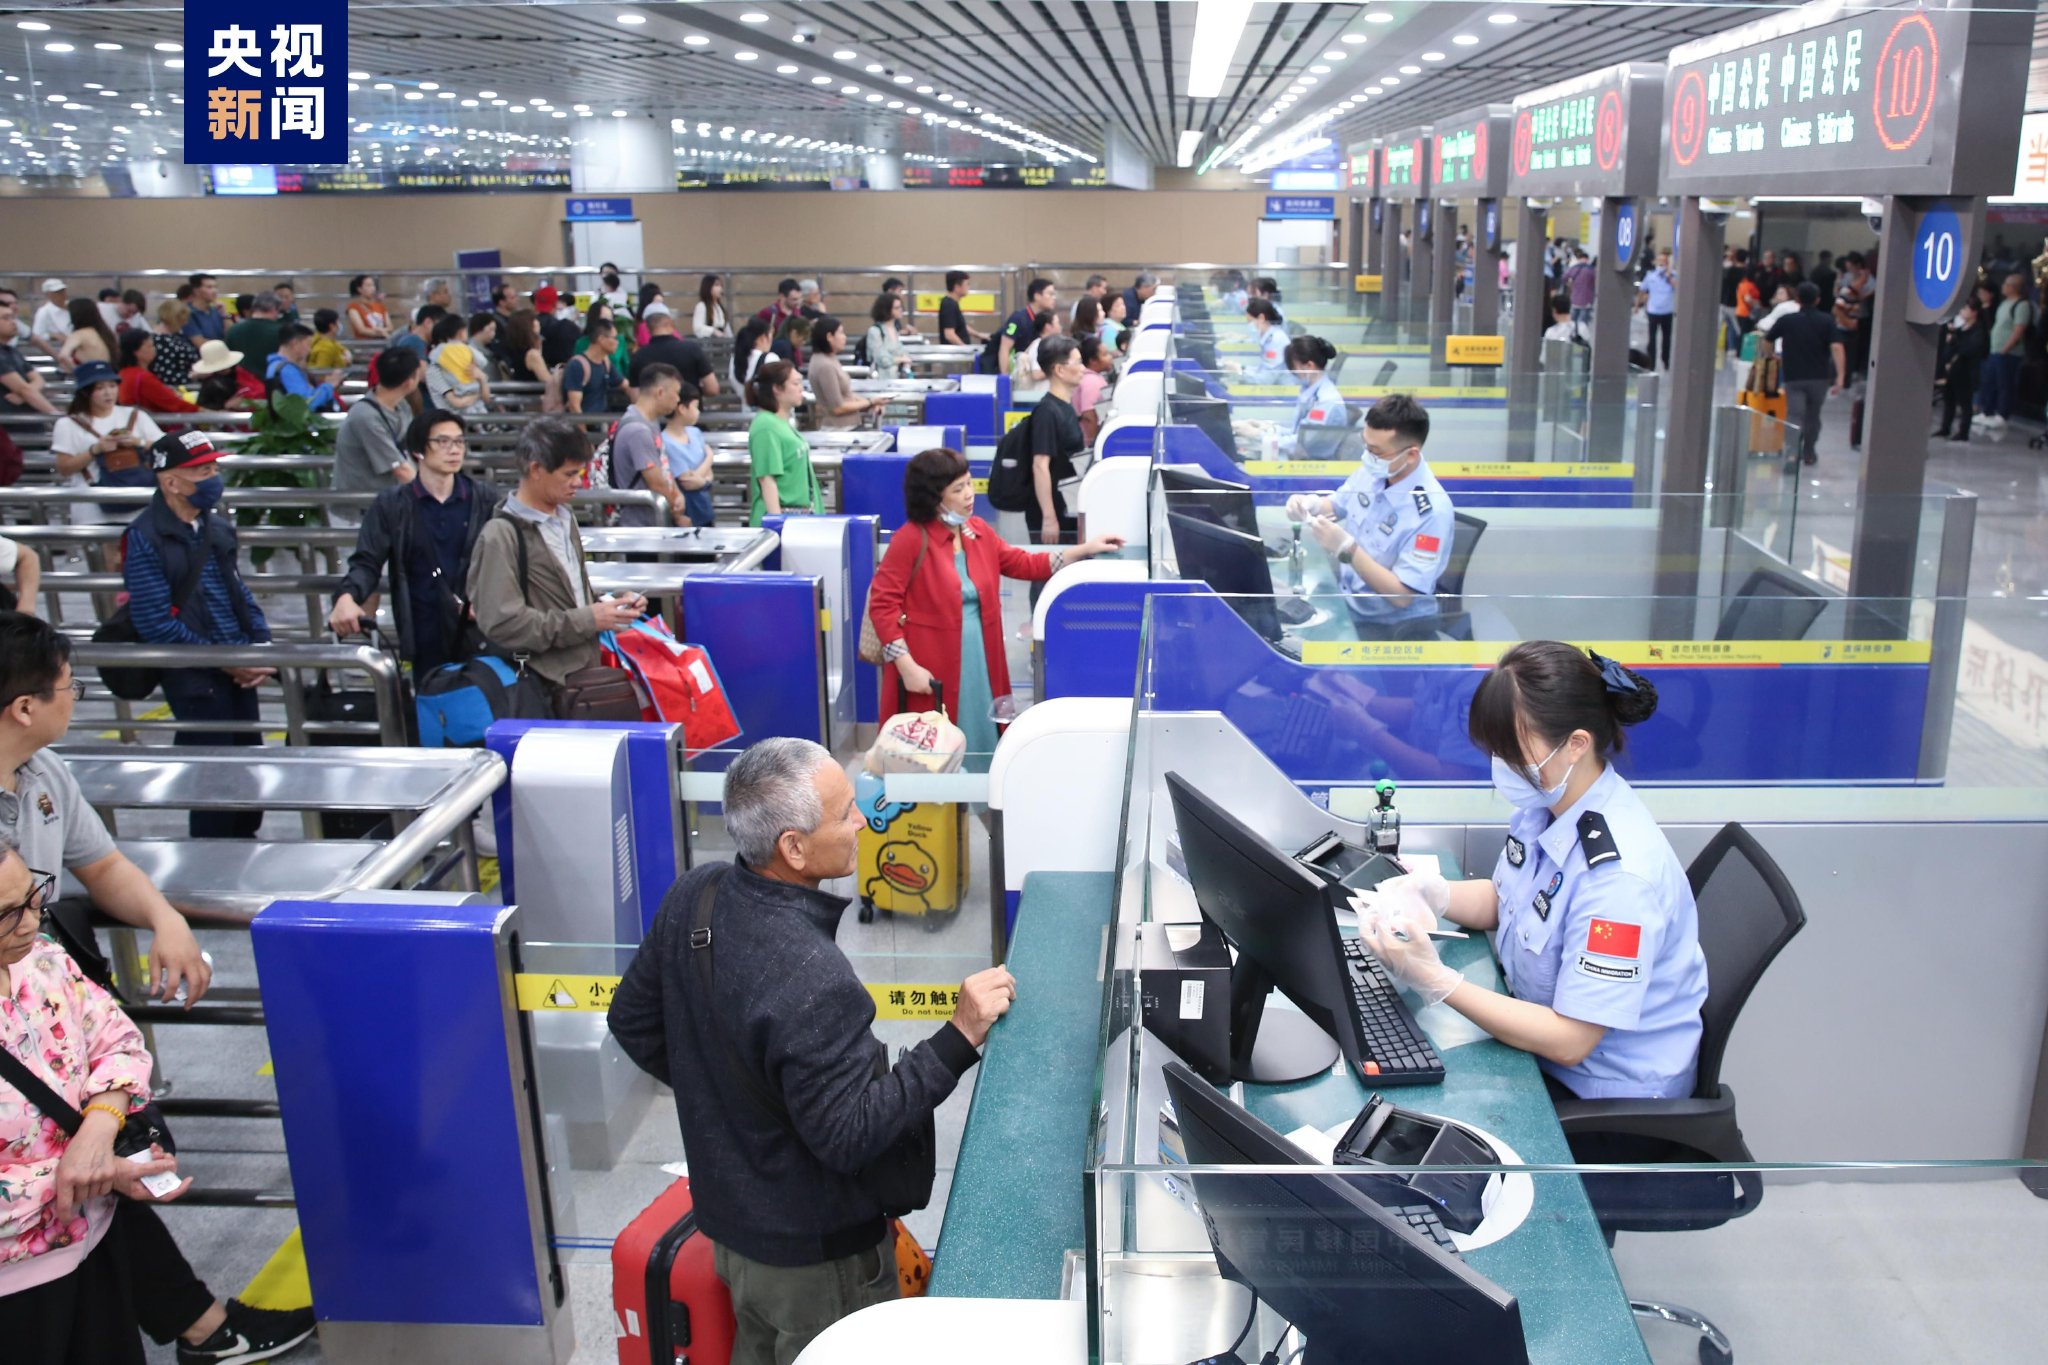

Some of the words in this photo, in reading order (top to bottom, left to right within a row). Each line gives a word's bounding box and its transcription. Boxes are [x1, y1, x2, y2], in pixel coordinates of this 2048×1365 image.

[1707, 53, 1770, 115] 中国公民
[1780, 29, 1862, 103] 中国公民
[1887, 45, 1924, 118] 10
[1618, 216, 1633, 247] 08
[1923, 232, 1953, 281] 10
